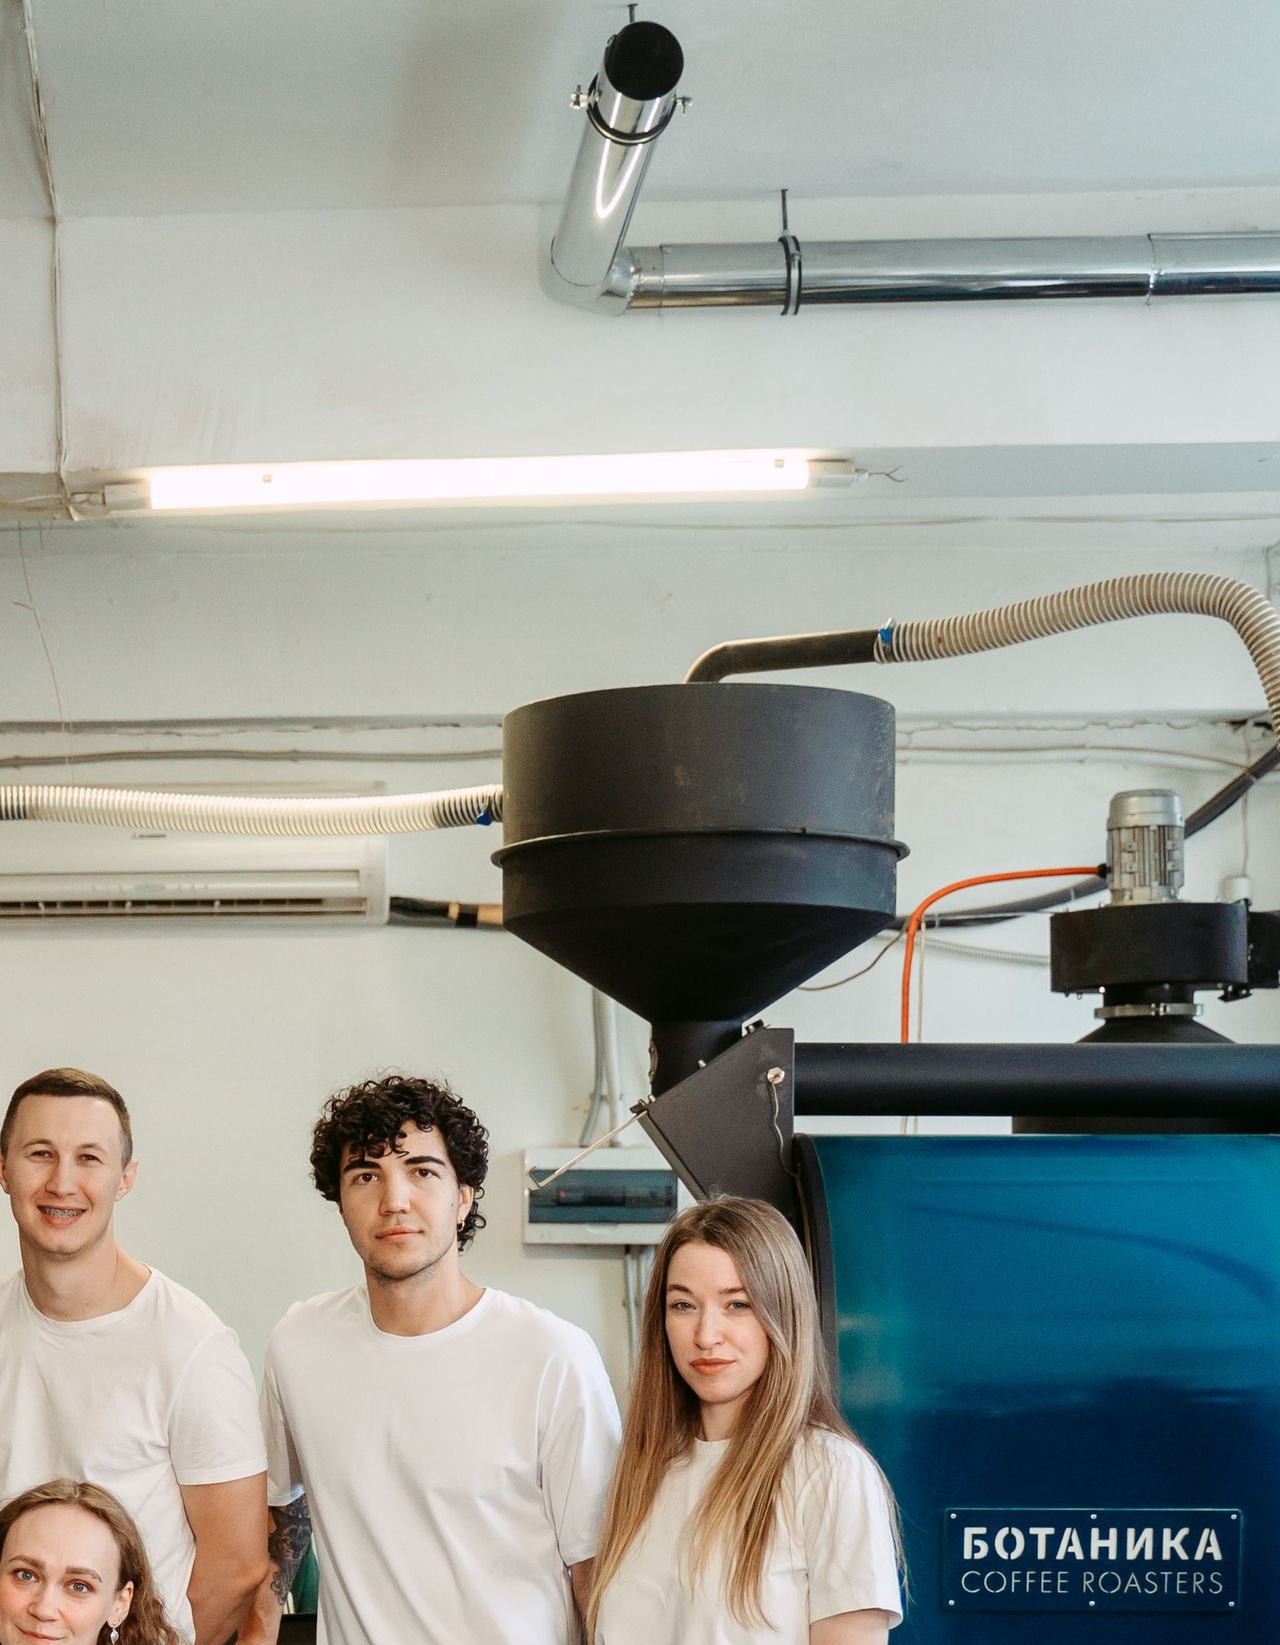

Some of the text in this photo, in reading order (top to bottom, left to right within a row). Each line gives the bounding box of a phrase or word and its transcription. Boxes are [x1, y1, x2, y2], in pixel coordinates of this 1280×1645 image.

[963, 1526, 1223, 1561] БОТАНИКА
[961, 1570, 1223, 1594] COFFEE ROASTERS
